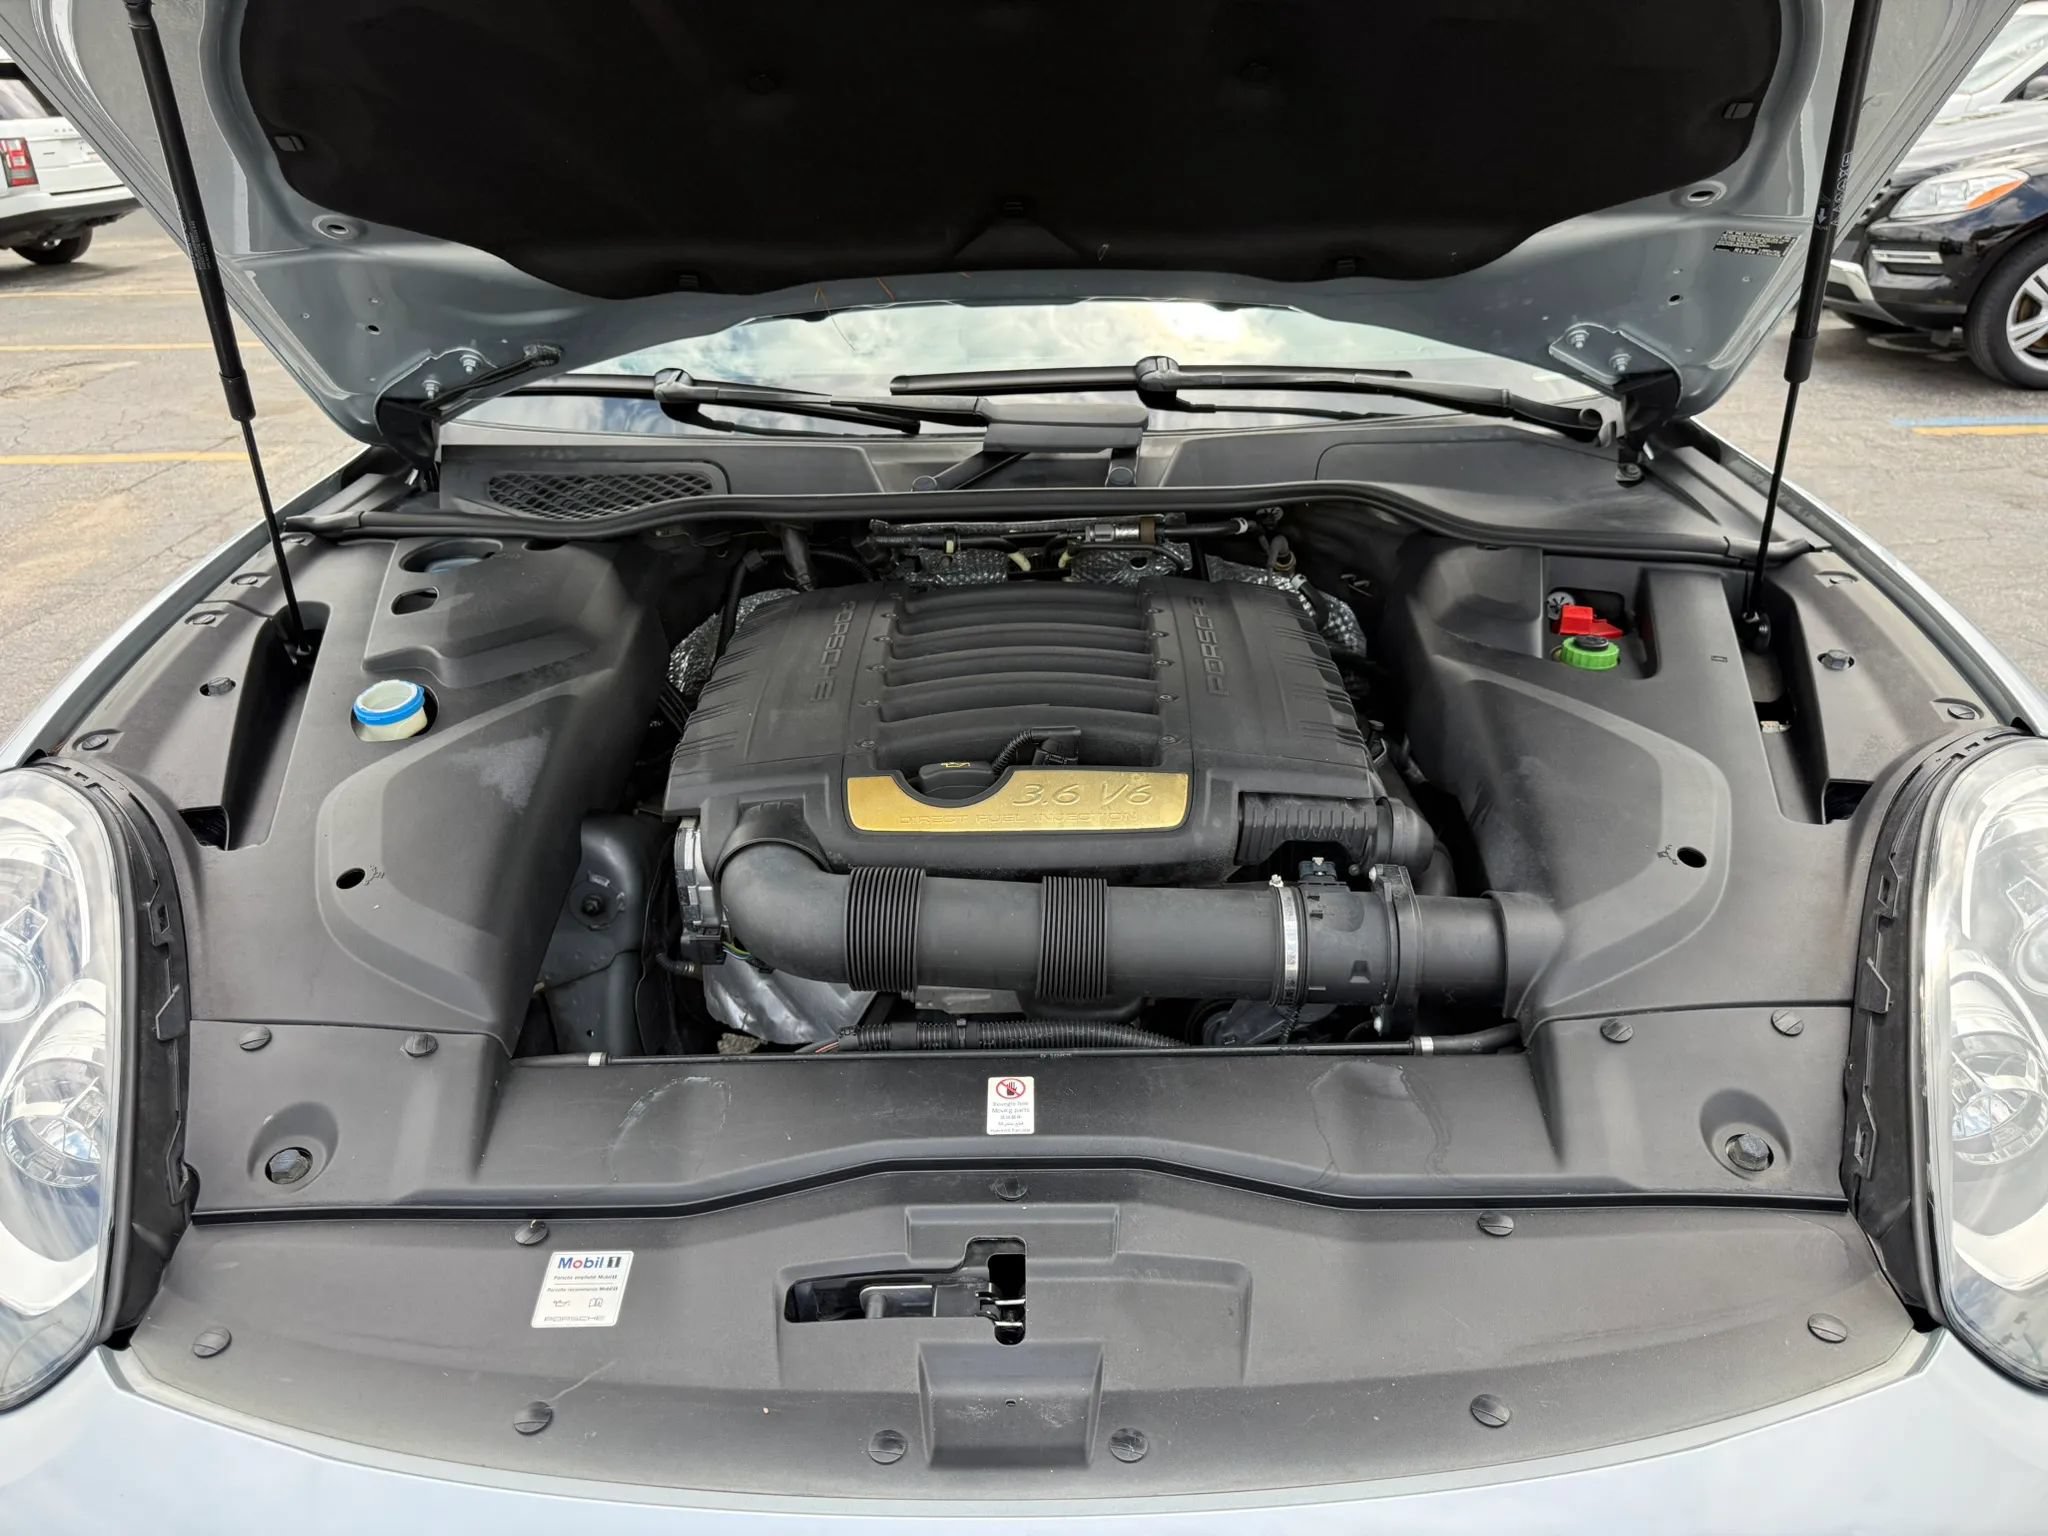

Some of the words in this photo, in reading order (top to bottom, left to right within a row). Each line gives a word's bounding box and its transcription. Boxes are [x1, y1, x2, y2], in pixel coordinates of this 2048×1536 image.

[1012, 783, 1080, 806] 3.6
[1101, 783, 1153, 806] V6
[899, 813, 968, 825] DIRECT
[975, 812, 1025, 824] FUEL
[1033, 811, 1137, 823] INJECTION
[557, 1257, 604, 1269] Mobil
[606, 1256, 622, 1268] 1
